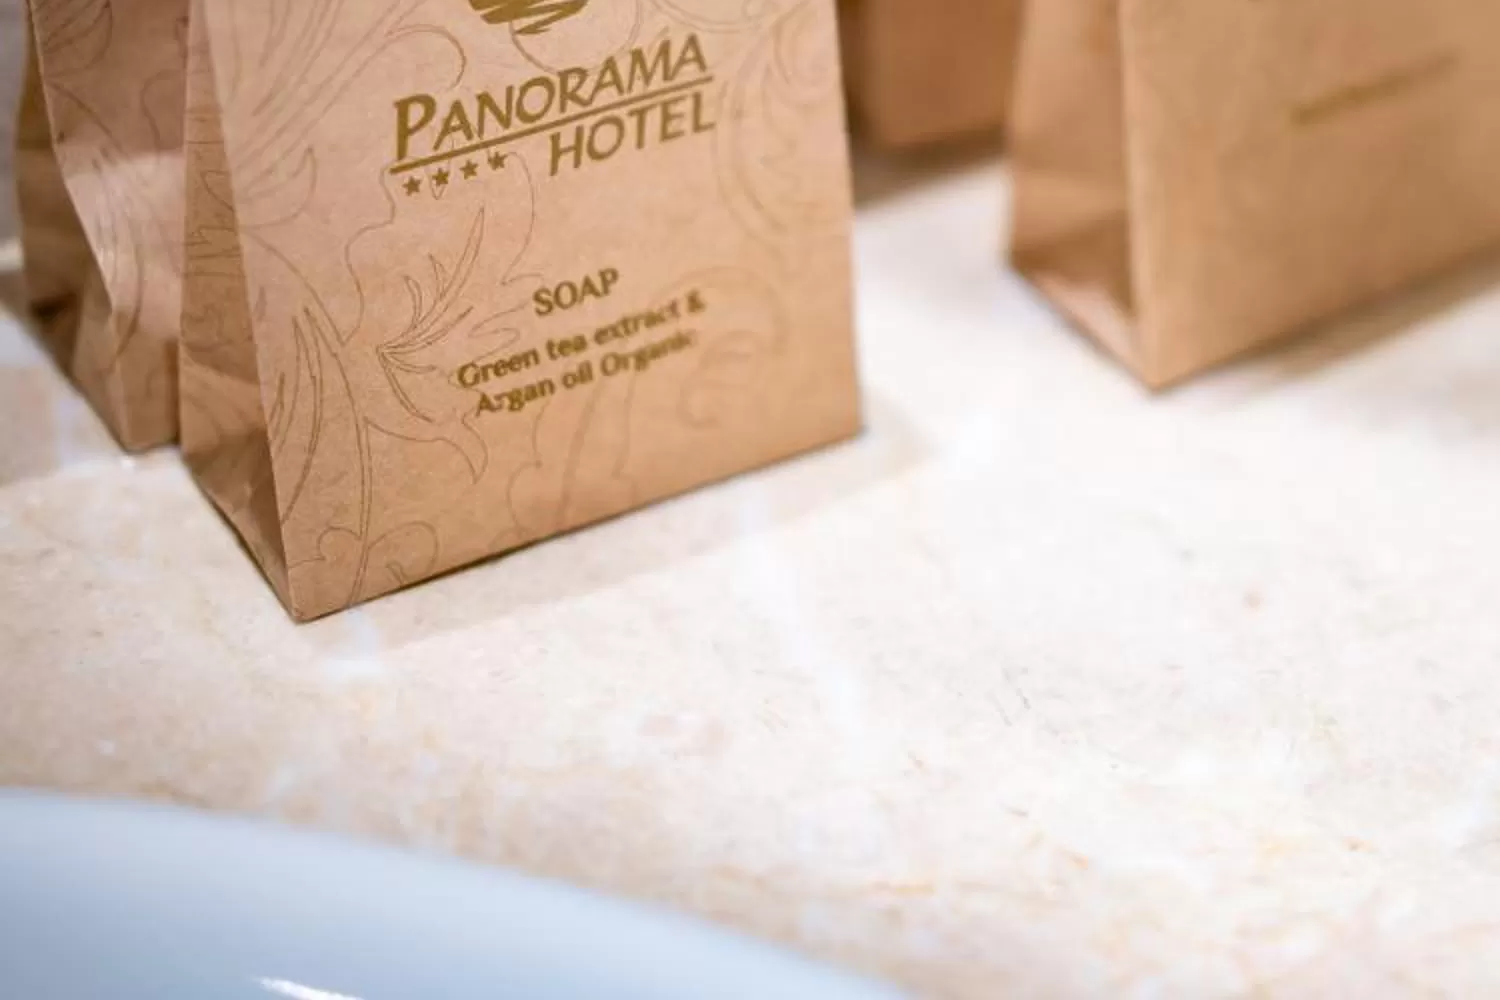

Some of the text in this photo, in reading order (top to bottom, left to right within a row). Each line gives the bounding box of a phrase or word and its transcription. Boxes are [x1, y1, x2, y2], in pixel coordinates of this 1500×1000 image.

[394, 32, 707, 161] PANORAMA
[549, 92, 715, 176] HOTEL
[532, 267, 620, 317] SOAP
[457, 289, 706, 388] Green tea extract &
[475, 376, 556, 417] Argan
[561, 360, 593, 389] oil
